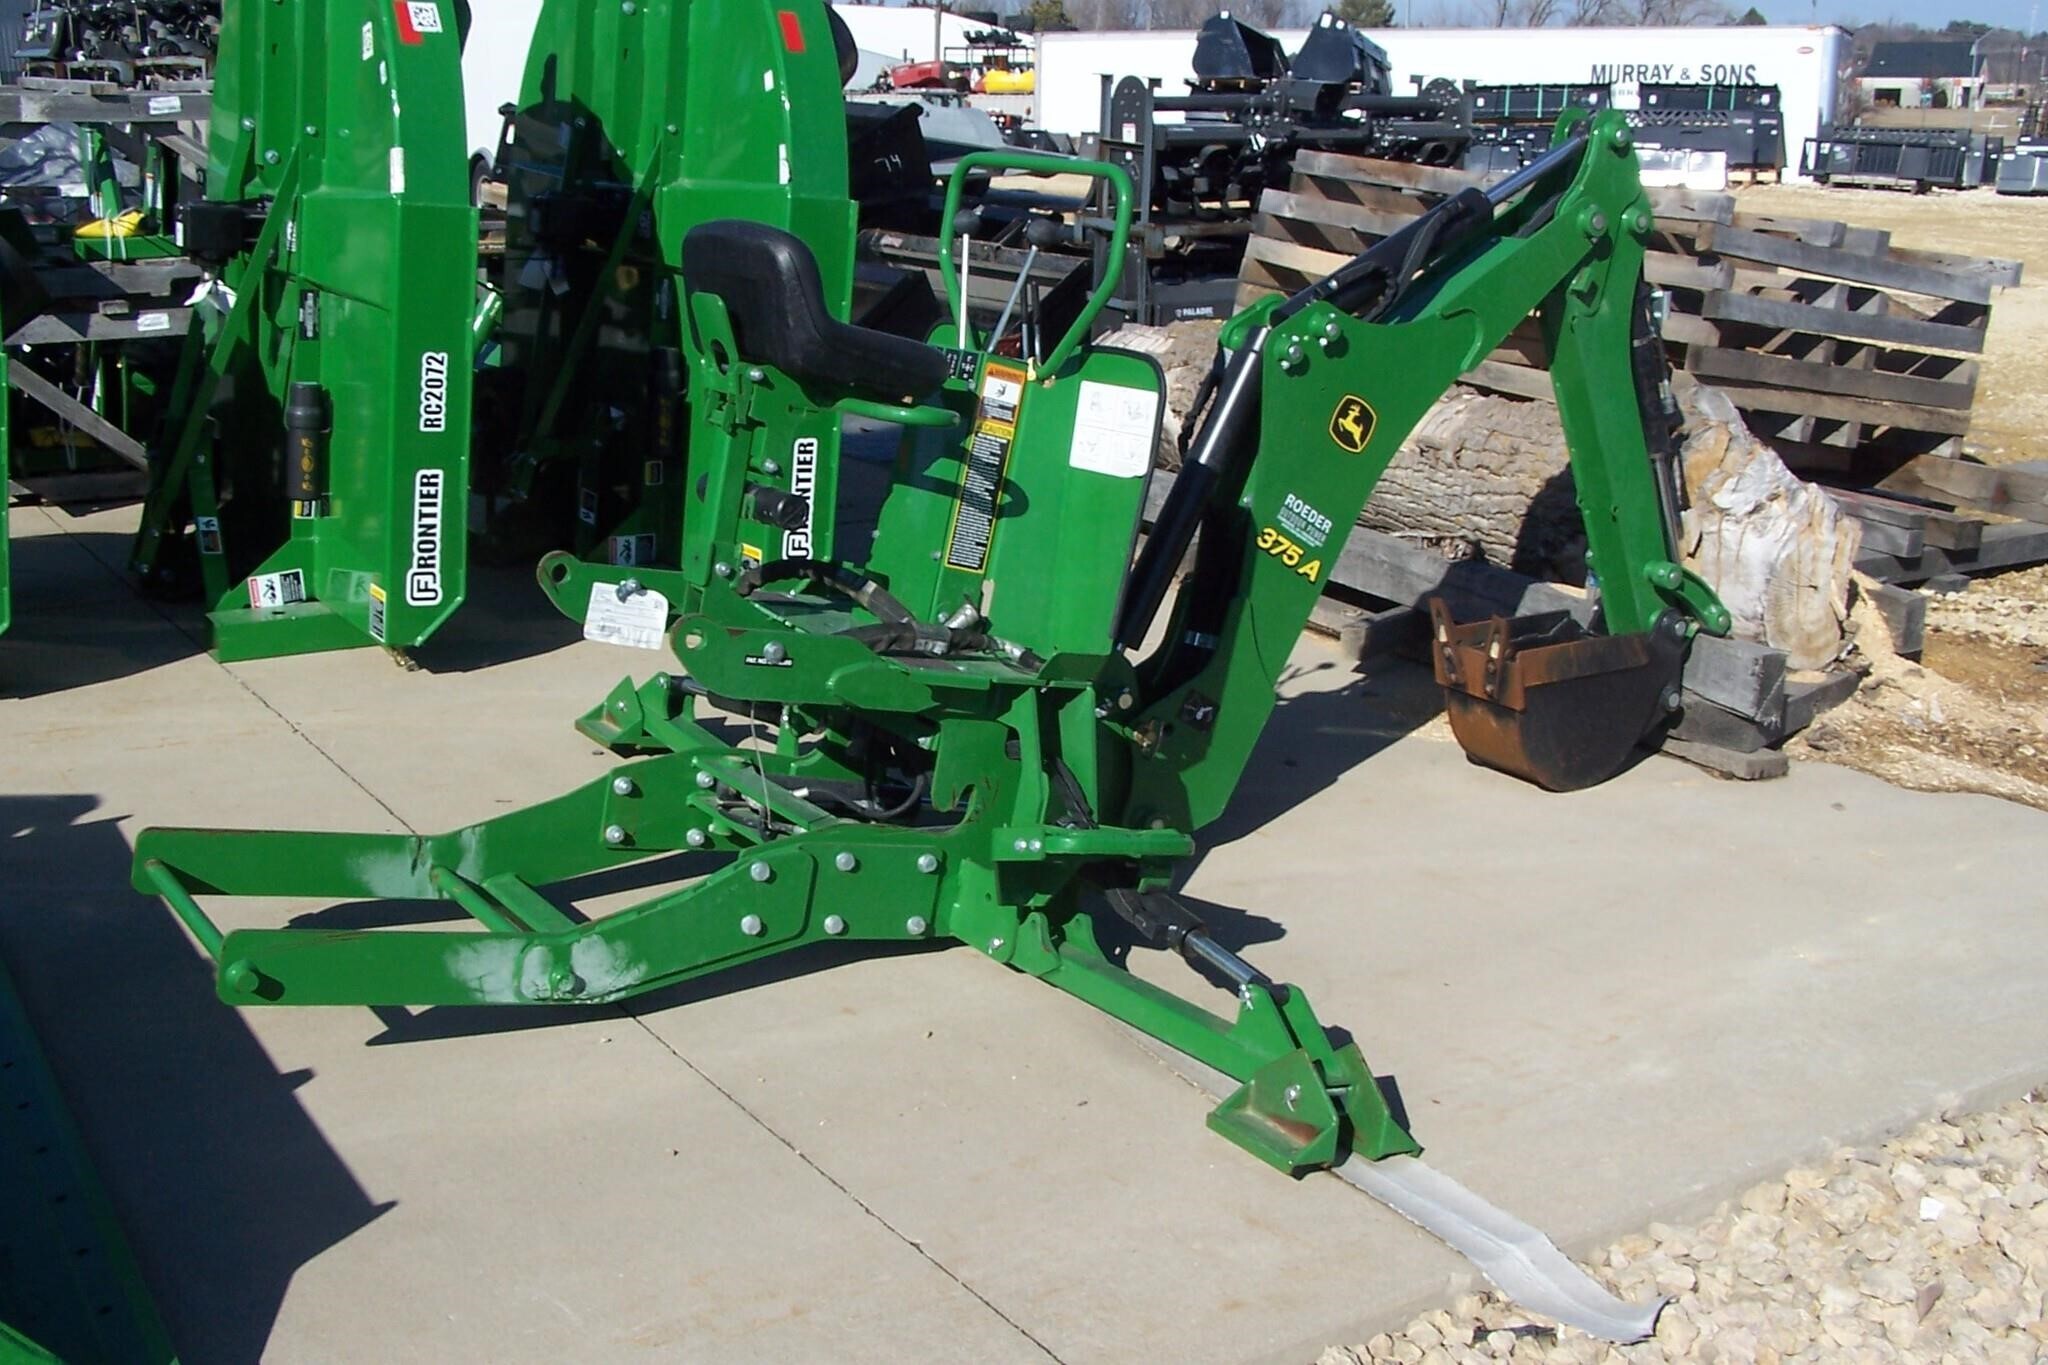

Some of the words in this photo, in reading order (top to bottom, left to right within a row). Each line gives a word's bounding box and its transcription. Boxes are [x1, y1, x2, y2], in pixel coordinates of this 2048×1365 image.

[1590, 64, 1674, 84] MURRAY
[1679, 67, 1691, 81] &
[1700, 64, 1757, 84] SONS
[873, 154, 902, 172] 74
[423, 354, 446, 429] RC2072
[786, 441, 814, 560] FNTIER
[1284, 493, 1333, 534] ROEDER
[410, 472, 441, 601] FRONTIER
[1256, 527, 1305, 567] 375
[1296, 559, 1322, 583] A
